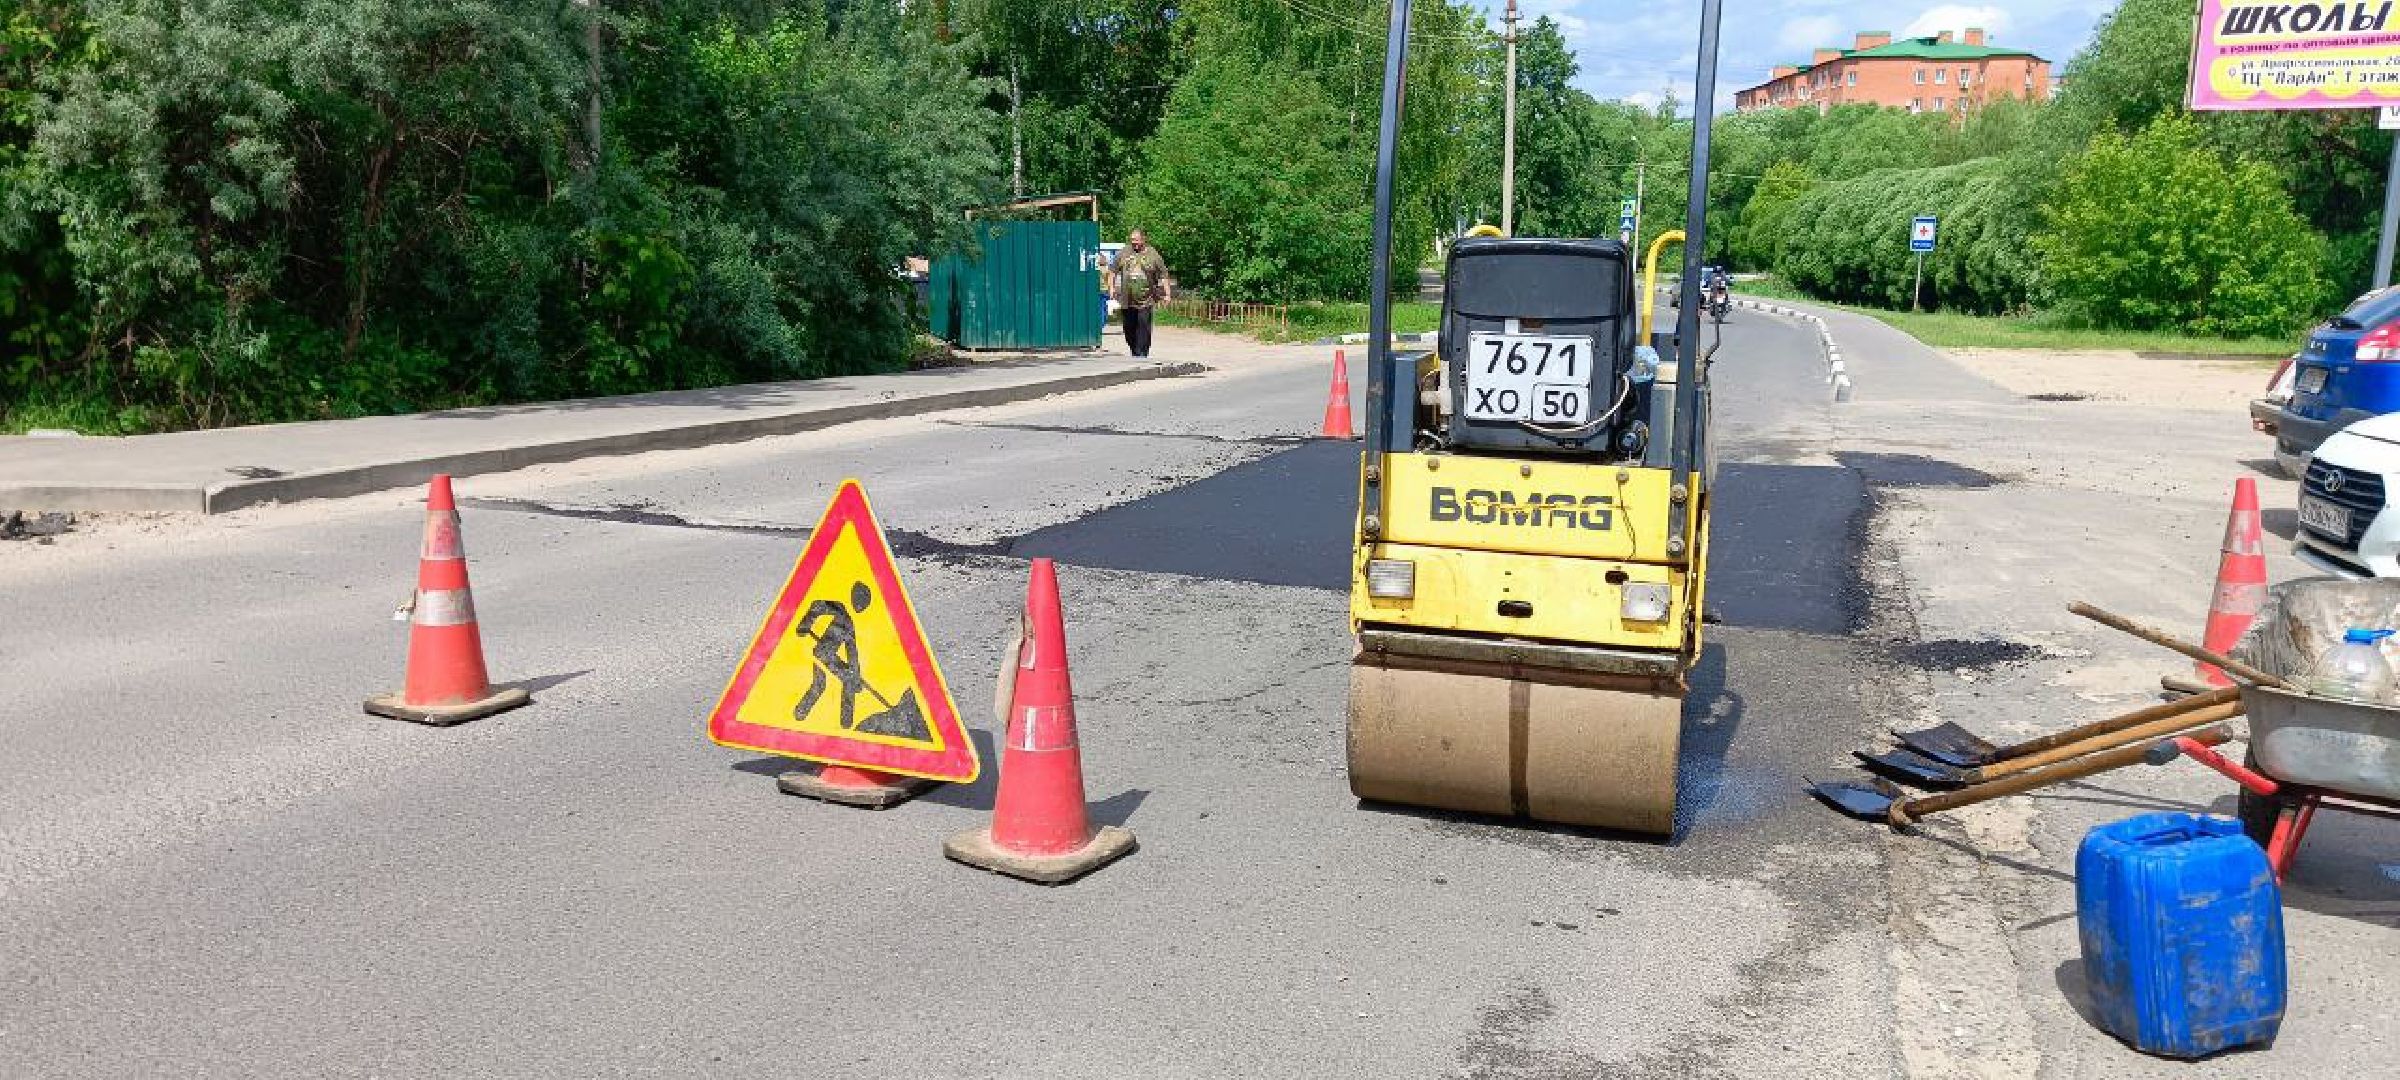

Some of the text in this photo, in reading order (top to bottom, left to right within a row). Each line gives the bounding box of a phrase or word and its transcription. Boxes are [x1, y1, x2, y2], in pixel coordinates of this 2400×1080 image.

[2221, 1, 2393, 35] ШКОЛЫ
[2241, 71, 2262, 87] ТЦ
[2345, 71, 2352, 83] 1
[2359, 72, 2399, 84] этаж
[1484, 341, 1577, 377] 7671
[1542, 391, 1579, 418] 50
[1430, 486, 1613, 531] BOMAG
